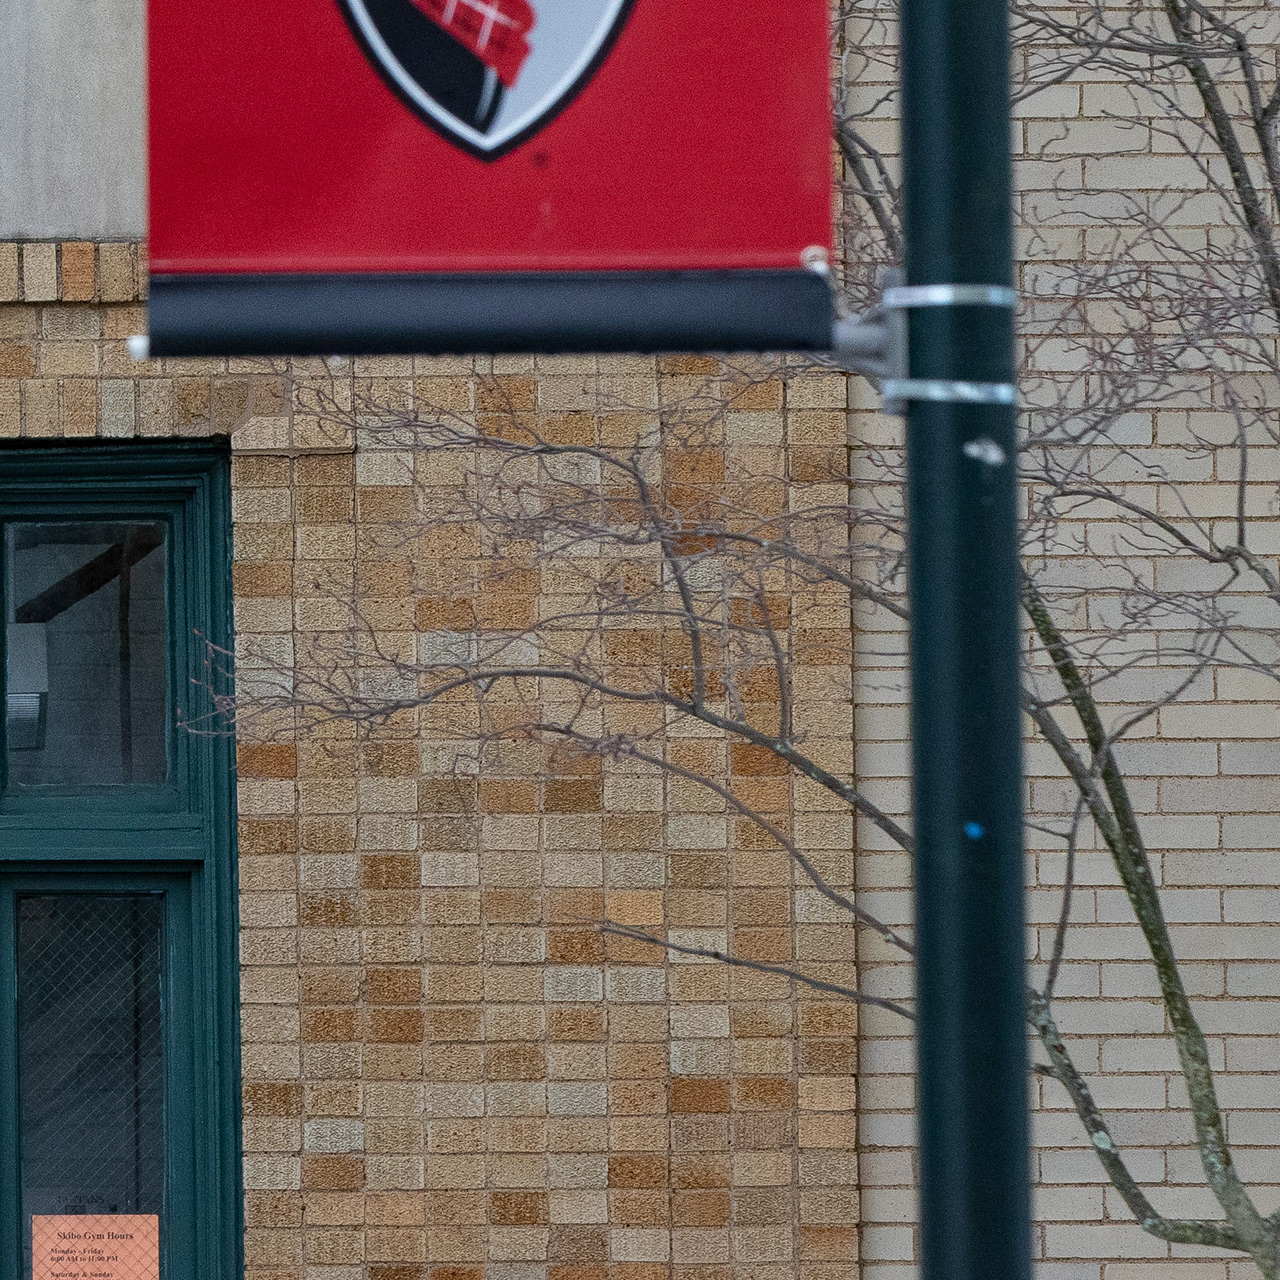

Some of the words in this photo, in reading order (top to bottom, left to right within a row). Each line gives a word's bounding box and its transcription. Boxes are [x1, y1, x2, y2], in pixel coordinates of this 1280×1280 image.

[57, 1231, 82, 1240] Skibo
[83, 1231, 105, 1242] Gym
[107, 1231, 134, 1240] Hours
[50, 1248, 77, 1256] Monday
[83, 1247, 104, 1256] Friday
